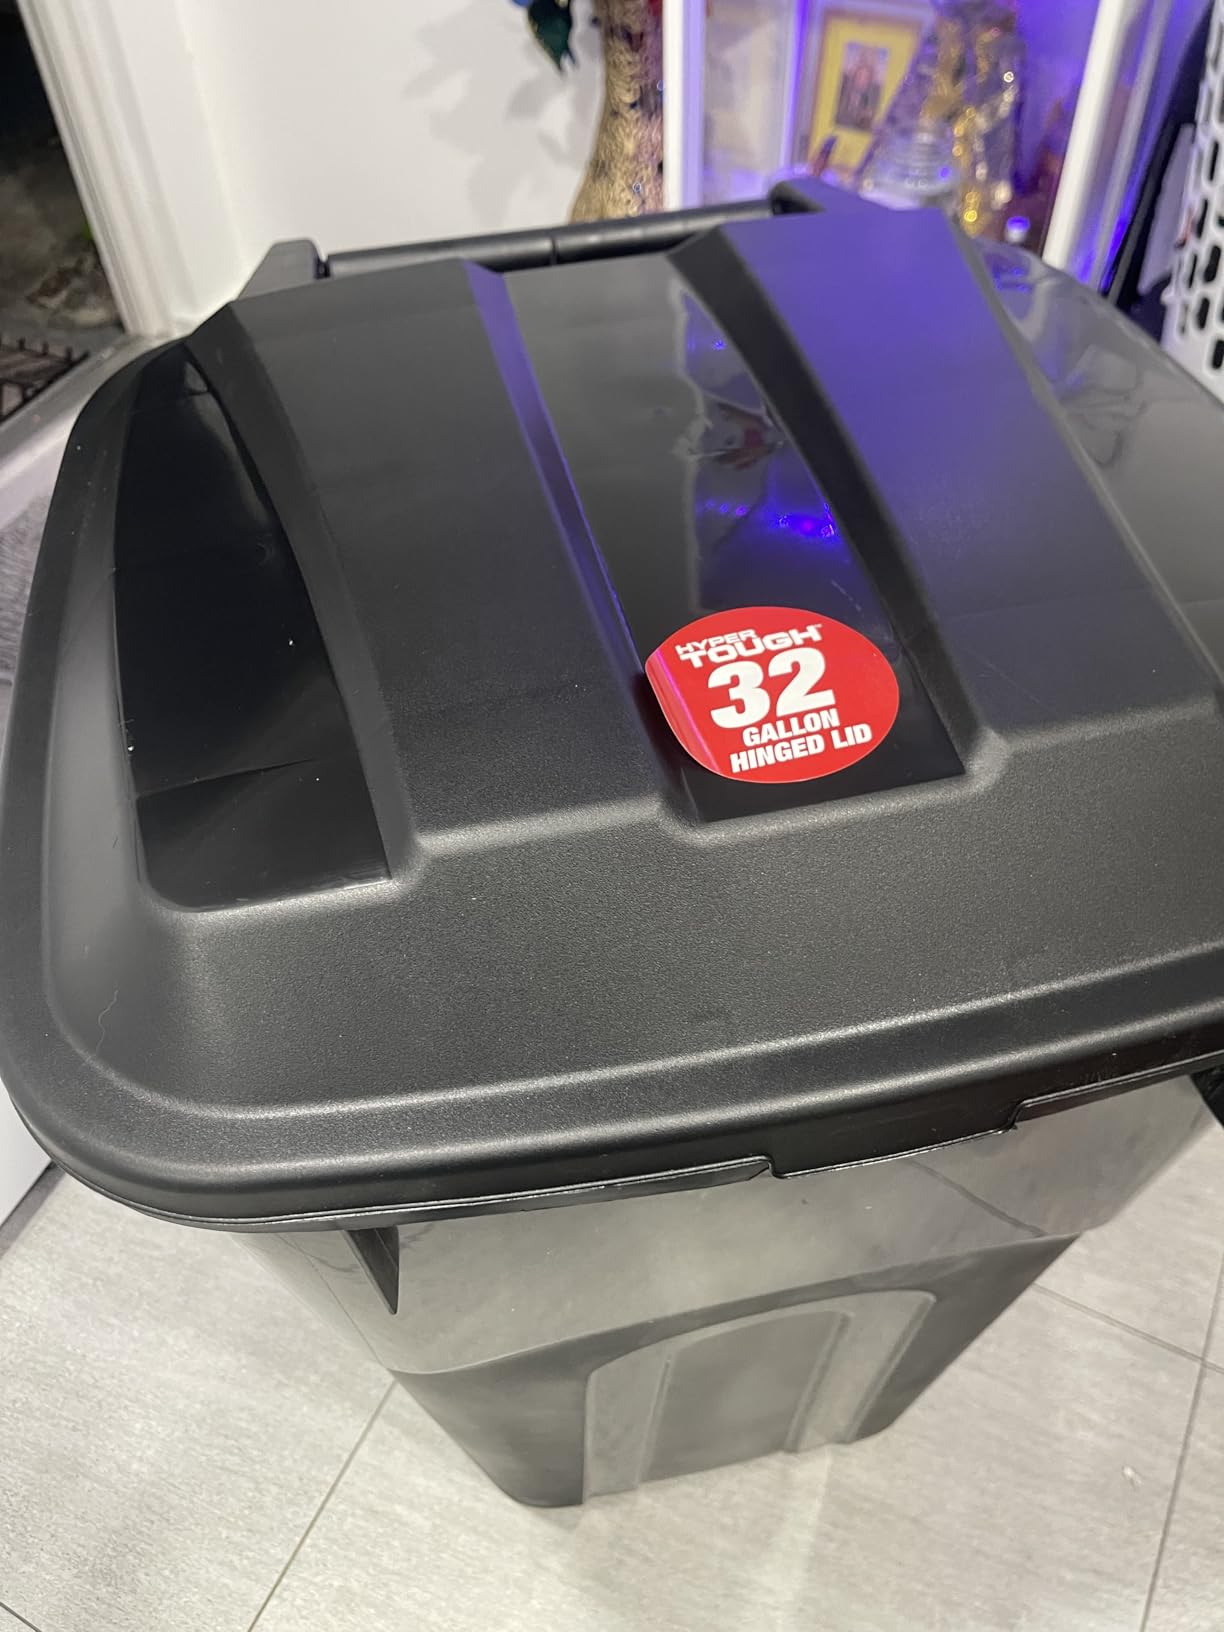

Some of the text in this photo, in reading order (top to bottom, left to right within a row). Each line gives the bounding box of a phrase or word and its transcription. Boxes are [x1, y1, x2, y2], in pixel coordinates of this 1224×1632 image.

[675, 629, 757, 655] HYPER
[680, 625, 822, 668] TOUGH
[708, 647, 836, 729] 32
[730, 723, 873, 773] HINGED LID
[742, 708, 840, 747] GALLON
